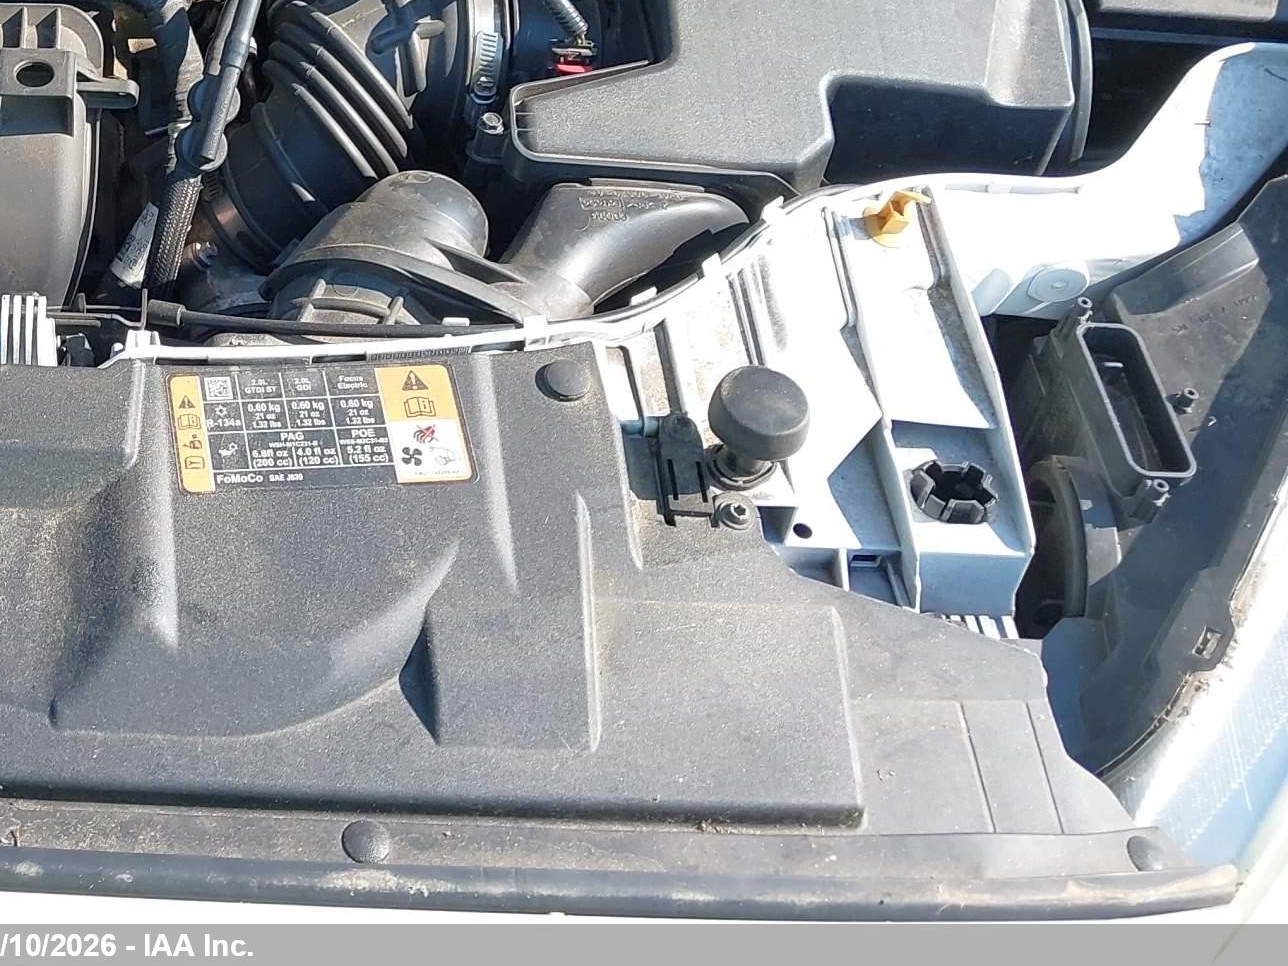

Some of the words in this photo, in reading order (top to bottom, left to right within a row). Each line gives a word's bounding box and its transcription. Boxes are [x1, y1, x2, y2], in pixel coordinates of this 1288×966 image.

[337, 382, 368, 390] Electric
[268, 403, 281, 413] kg
[312, 400, 325, 410] kg
[360, 399, 374, 409] kg
[206, 418, 242, 428] R-134a
[269, 420, 282, 428] lbs
[313, 418, 326, 426] lbs
[280, 432, 305, 441] PAG
[350, 429, 376, 438] POE
[296, 448, 312, 456] 4.0
[313, 446, 322, 455] fl
[323, 447, 337, 455] oz
[346, 446, 363, 454] 5.2
[363, 445, 372, 453] fl
[252, 458, 275, 469] (200
[276, 457, 293, 467] cc)
[298, 456, 321, 466] (120
[322, 455, 339, 466] cc)
[348, 454, 371, 464] (155
[372, 453, 389, 463] cc)
[216, 473, 264, 484] FoMoCo
[268, 474, 286, 482] SAE
